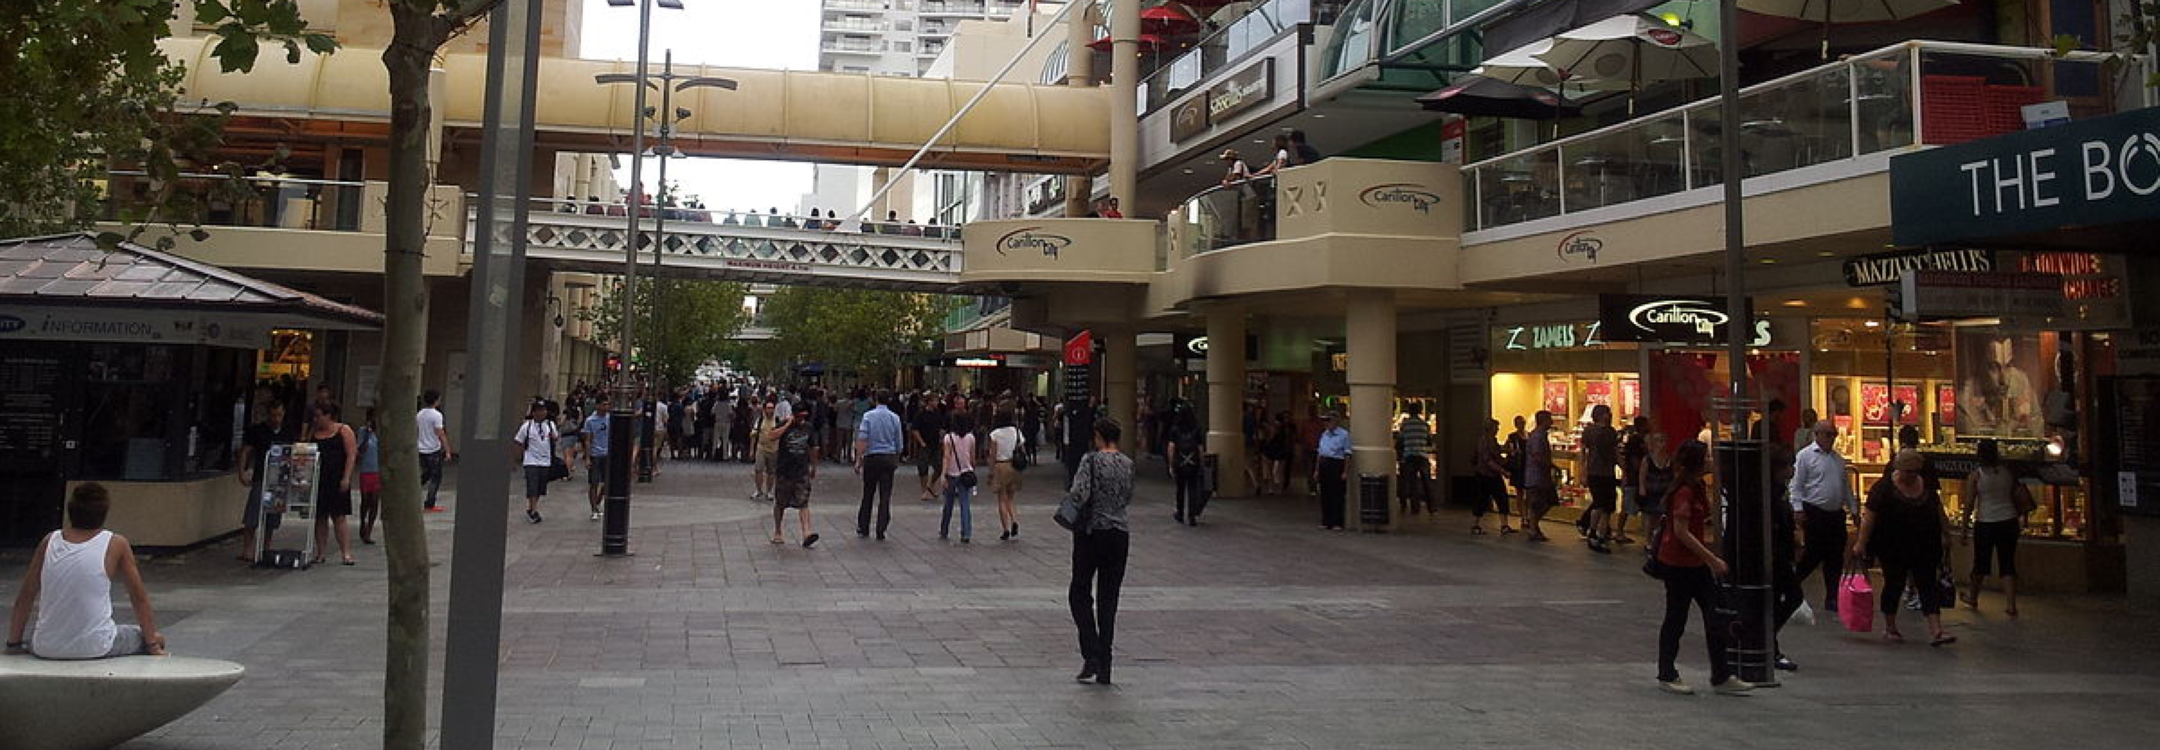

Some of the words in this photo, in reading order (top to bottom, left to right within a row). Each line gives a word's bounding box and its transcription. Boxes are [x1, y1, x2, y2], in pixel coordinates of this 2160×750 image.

[1961, 149, 2059, 217] THE
[1647, 304, 1698, 324] Carillon
[1533, 324, 1576, 349] ZAMELS
